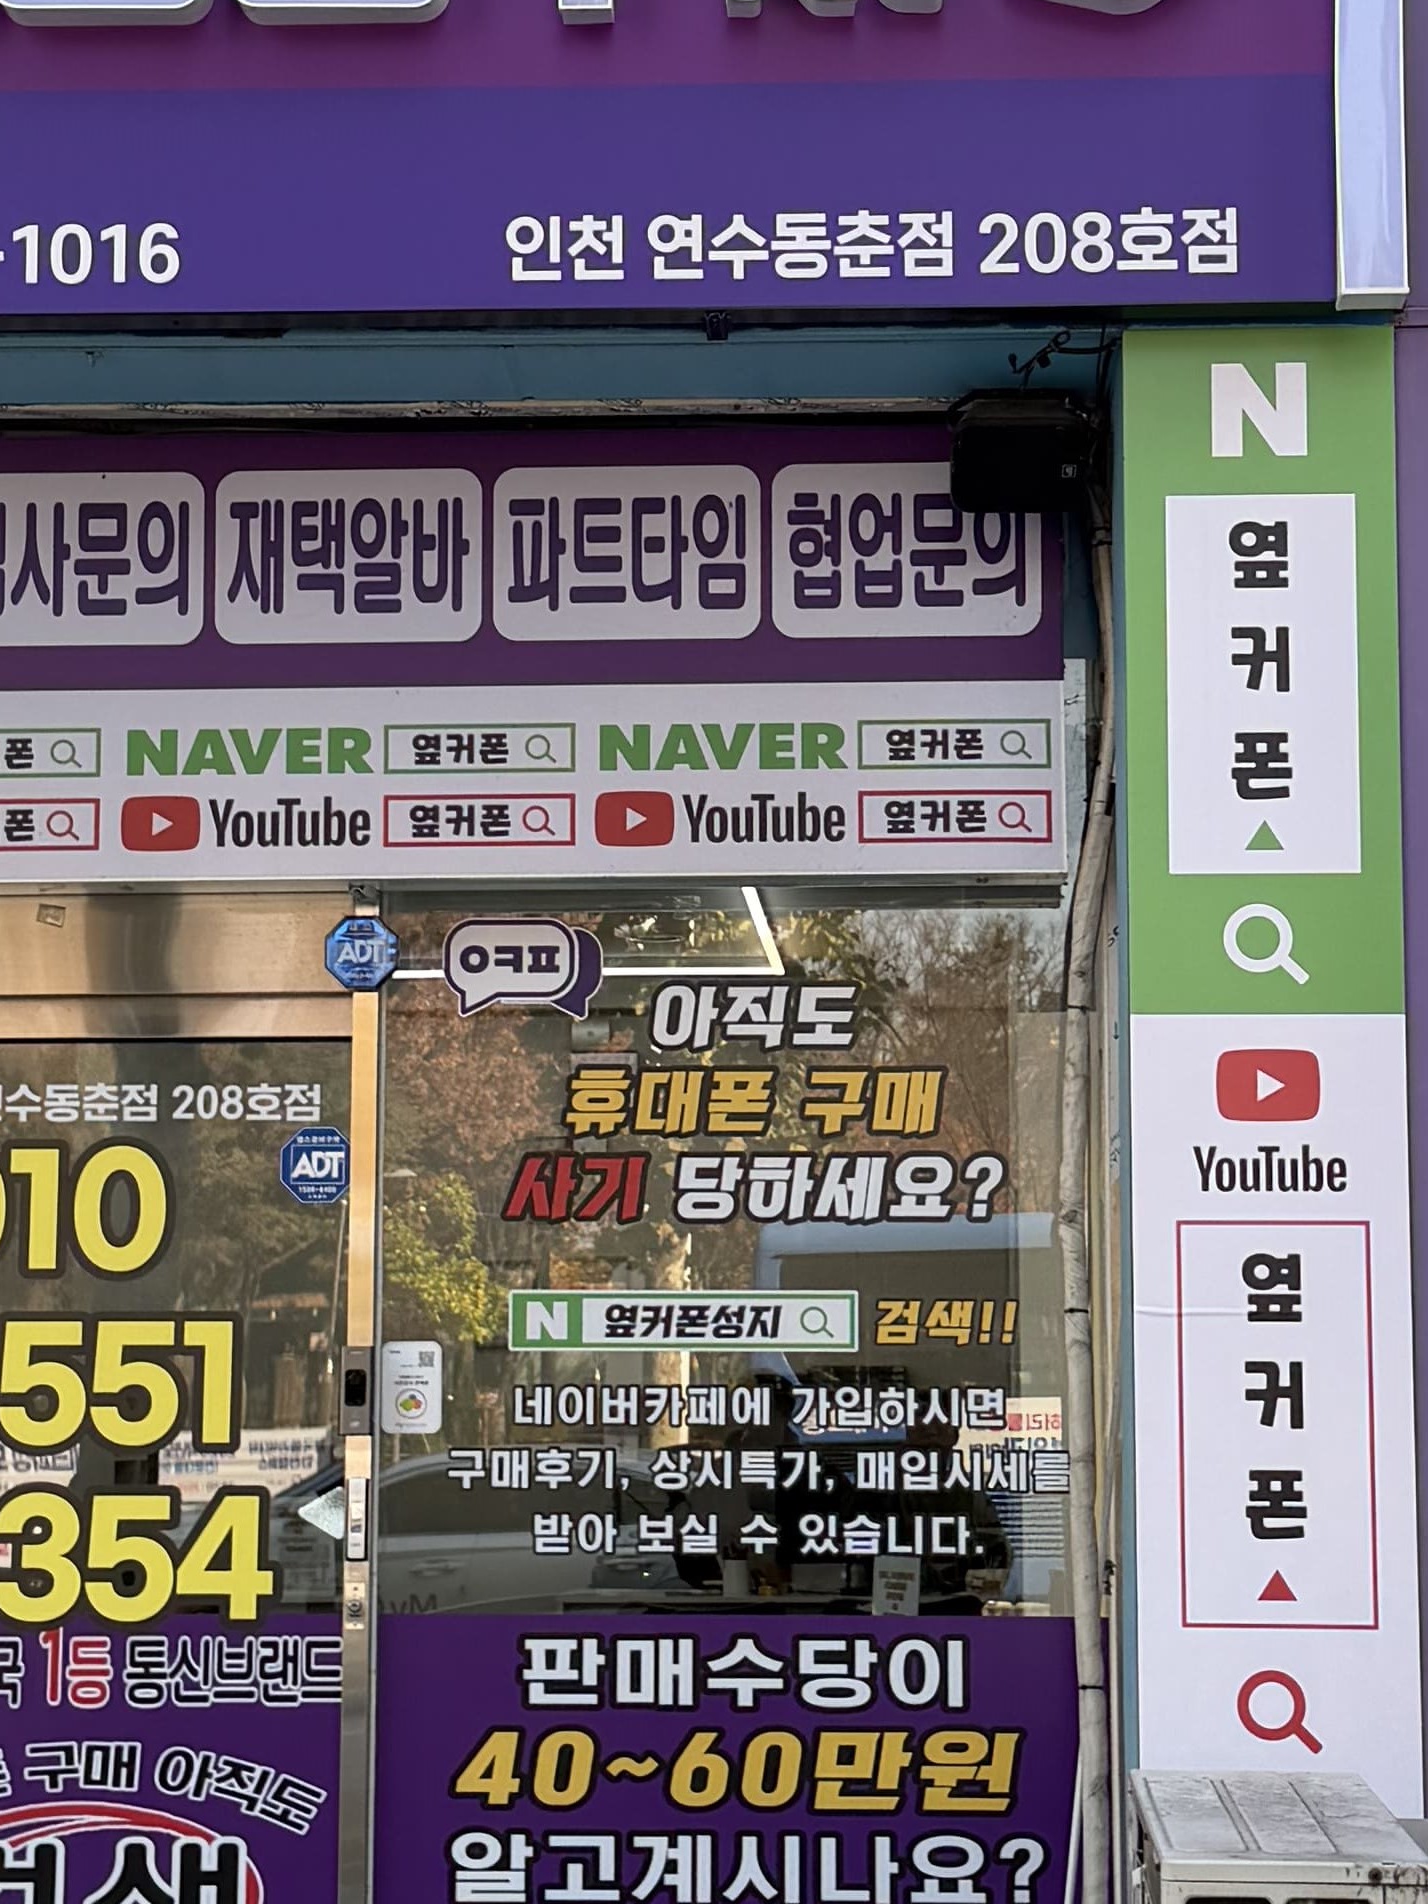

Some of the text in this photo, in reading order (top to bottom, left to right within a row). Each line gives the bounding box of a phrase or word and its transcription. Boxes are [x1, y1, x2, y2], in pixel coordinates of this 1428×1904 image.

[505, 207, 1239, 284] 인천 연수동춘점 208호점
[1211, 363, 1307, 456] N
[226, 499, 470, 615] 재택알바
[508, 495, 747, 611] 파트타임
[787, 492, 1027, 609] 협업문의
[126, 727, 373, 775] NAVER
[412, 733, 509, 765] 옆커폰
[599, 723, 845, 771] NAVER
[885, 728, 984, 760] 옆커폰
[210, 797, 370, 848] YouTube
[409, 804, 511, 838] 옆커폰
[684, 792, 844, 843] YouTube
[884, 800, 987, 834] 옆커폰
[337, 939, 384, 963] ADT
[652, 984, 857, 1050] 아직도
[172, 1083, 321, 1121] 208호점
[565, 1069, 943, 1134] 휴대폰 구매
[292, 1151, 344, 1178] ADT
[503, 1156, 1005, 1220] 사기 당하세요?
[1195, 1145, 1347, 1195] YouTube
[604, 1304, 782, 1338] 옆커폰성지
[876, 1301, 1016, 1345] 검색!!
[513, 1386, 1006, 1427] 네이버카페에 가입하시면
[448, 1450, 630, 1491] 구매후기,
[857, 1450, 1070, 1491] 매입시세를
[534, 1513, 986, 1555] 받아 보실 수 있습니다.
[40, 1628, 112, 1709] 1등
[125, 1636, 343, 1707] 통신브랜드
[523, 1638, 963, 1707] 판매수당이
[25, 1742, 140, 1791] 구매
[157, 1748, 327, 1835] 아직도
[454, 1731, 1022, 1811] 40~60만원
[451, 1833, 1045, 1904] 알고계시나요?
